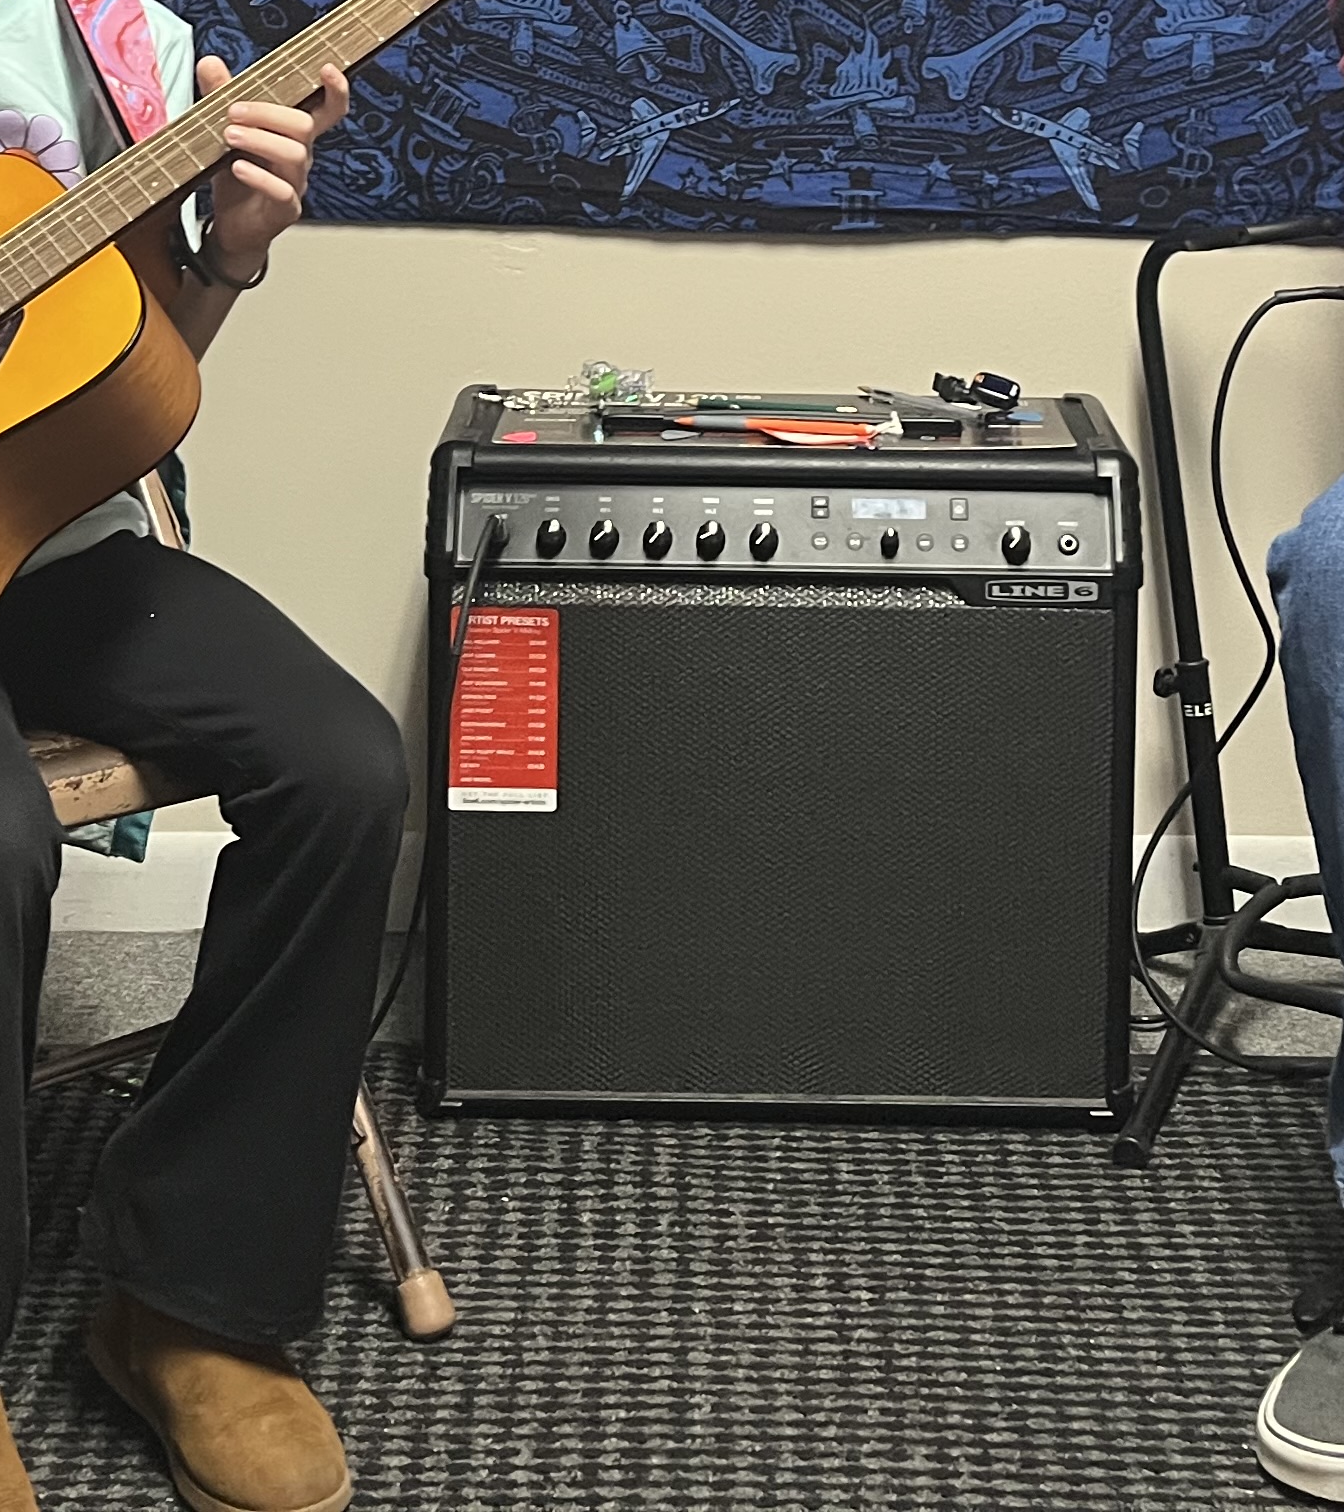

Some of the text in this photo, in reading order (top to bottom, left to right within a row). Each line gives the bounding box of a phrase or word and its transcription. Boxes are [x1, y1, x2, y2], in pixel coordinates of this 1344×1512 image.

[991, 585, 1094, 597] LINE 6
[467, 615, 550, 627] RTIST PRESETS
